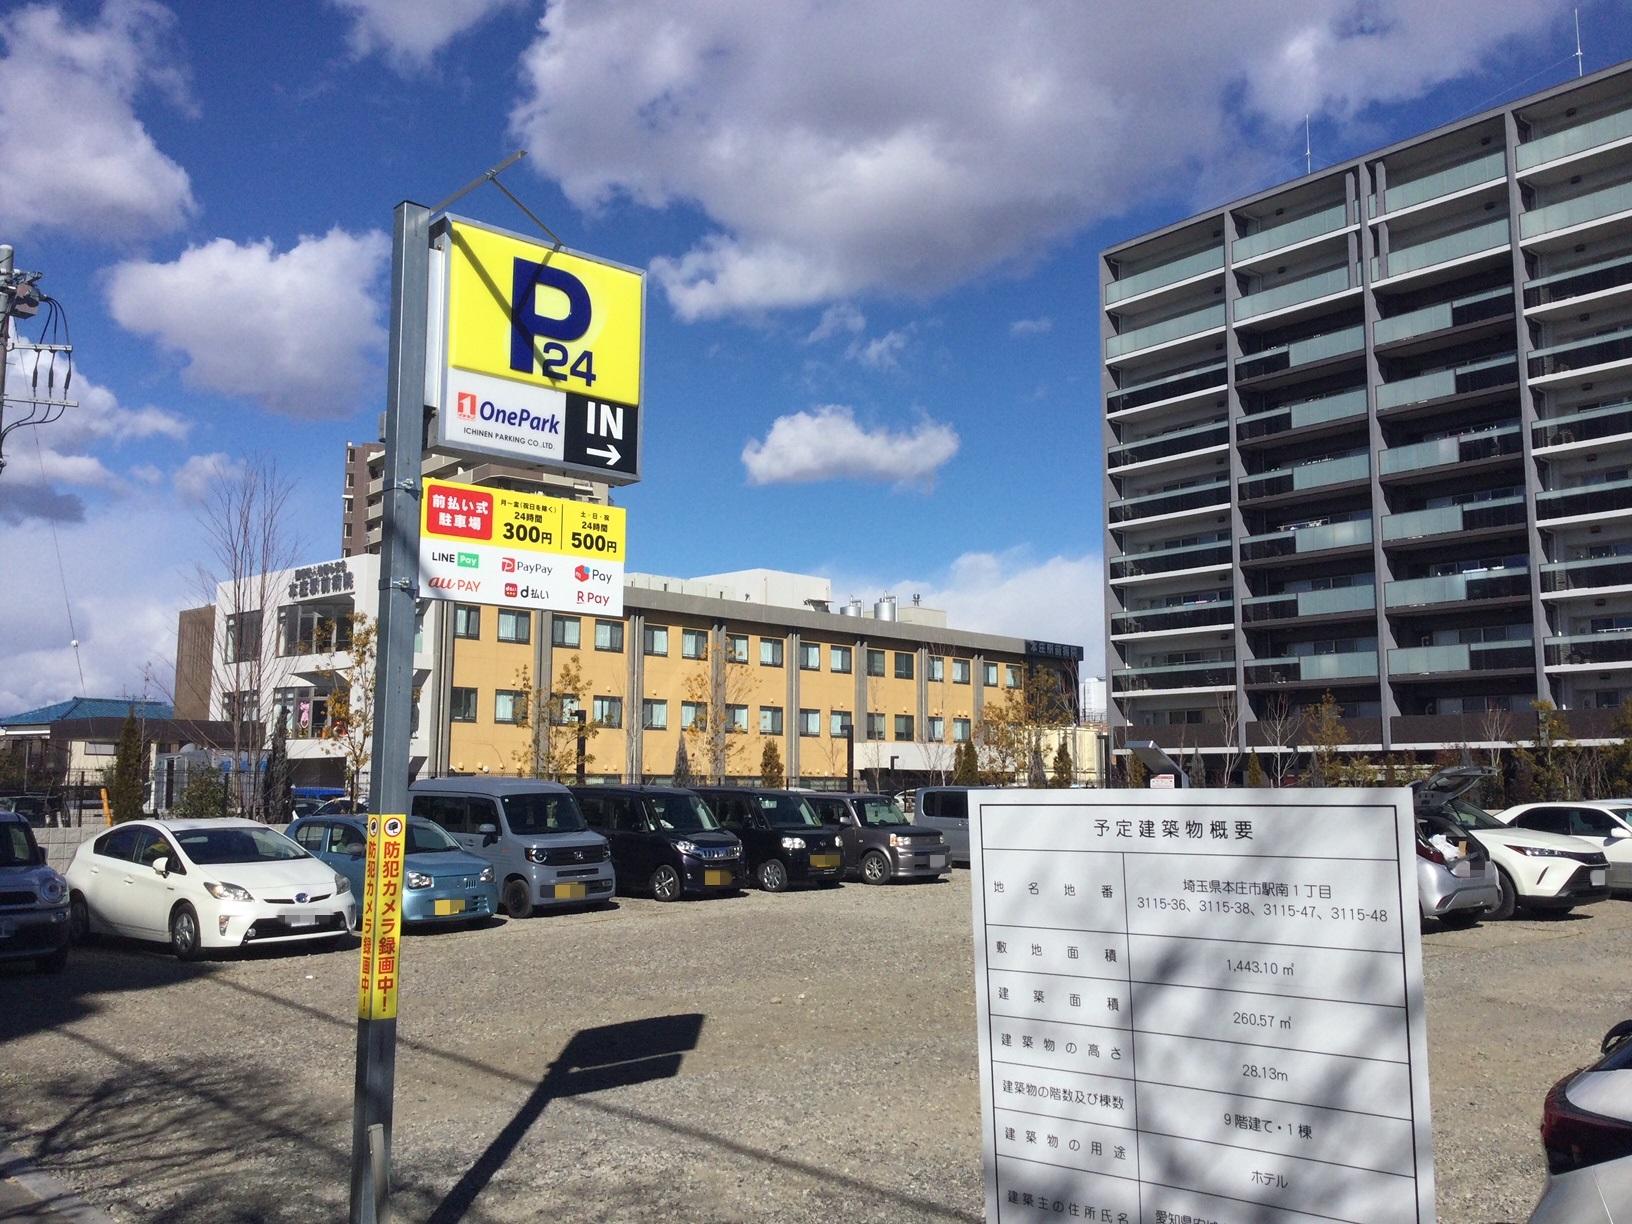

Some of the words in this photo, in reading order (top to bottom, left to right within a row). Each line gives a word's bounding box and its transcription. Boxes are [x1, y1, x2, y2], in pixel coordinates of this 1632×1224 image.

[510, 256, 592, 375] P
[542, 342, 597, 387] 24
[480, 401, 560, 435] OnePark
[586, 401, 623, 440] IN
[463, 427, 493, 439] ICHINEN
[495, 432, 526, 445] PARKING
[432, 494, 489, 515] 前払い式
[438, 512, 482, 531] 駐車場
[514, 511, 543, 523] 24時間
[503, 522, 552, 545] 300円
[581, 521, 608, 533] 24時間
[571, 531, 617, 553] 500円
[432, 552, 455, 563] LINE
[460, 555, 477, 566] Pay
[517, 561, 553, 576] PayPay
[428, 577, 456, 590] au
[457, 579, 480, 593] PAY
[592, 569, 613, 584] Pay
[587, 592, 610, 606] Pay
[1093, 819, 1254, 841] 予定建築物概要
[377, 841, 401, 1013] 防犯カメラ録画中！
[1242, 1063, 1288, 1081] 28.13m
[1002, 1079, 1125, 1111] 建築物の階数及び棟数
[1251, 1170, 1289, 1189] ホテル
